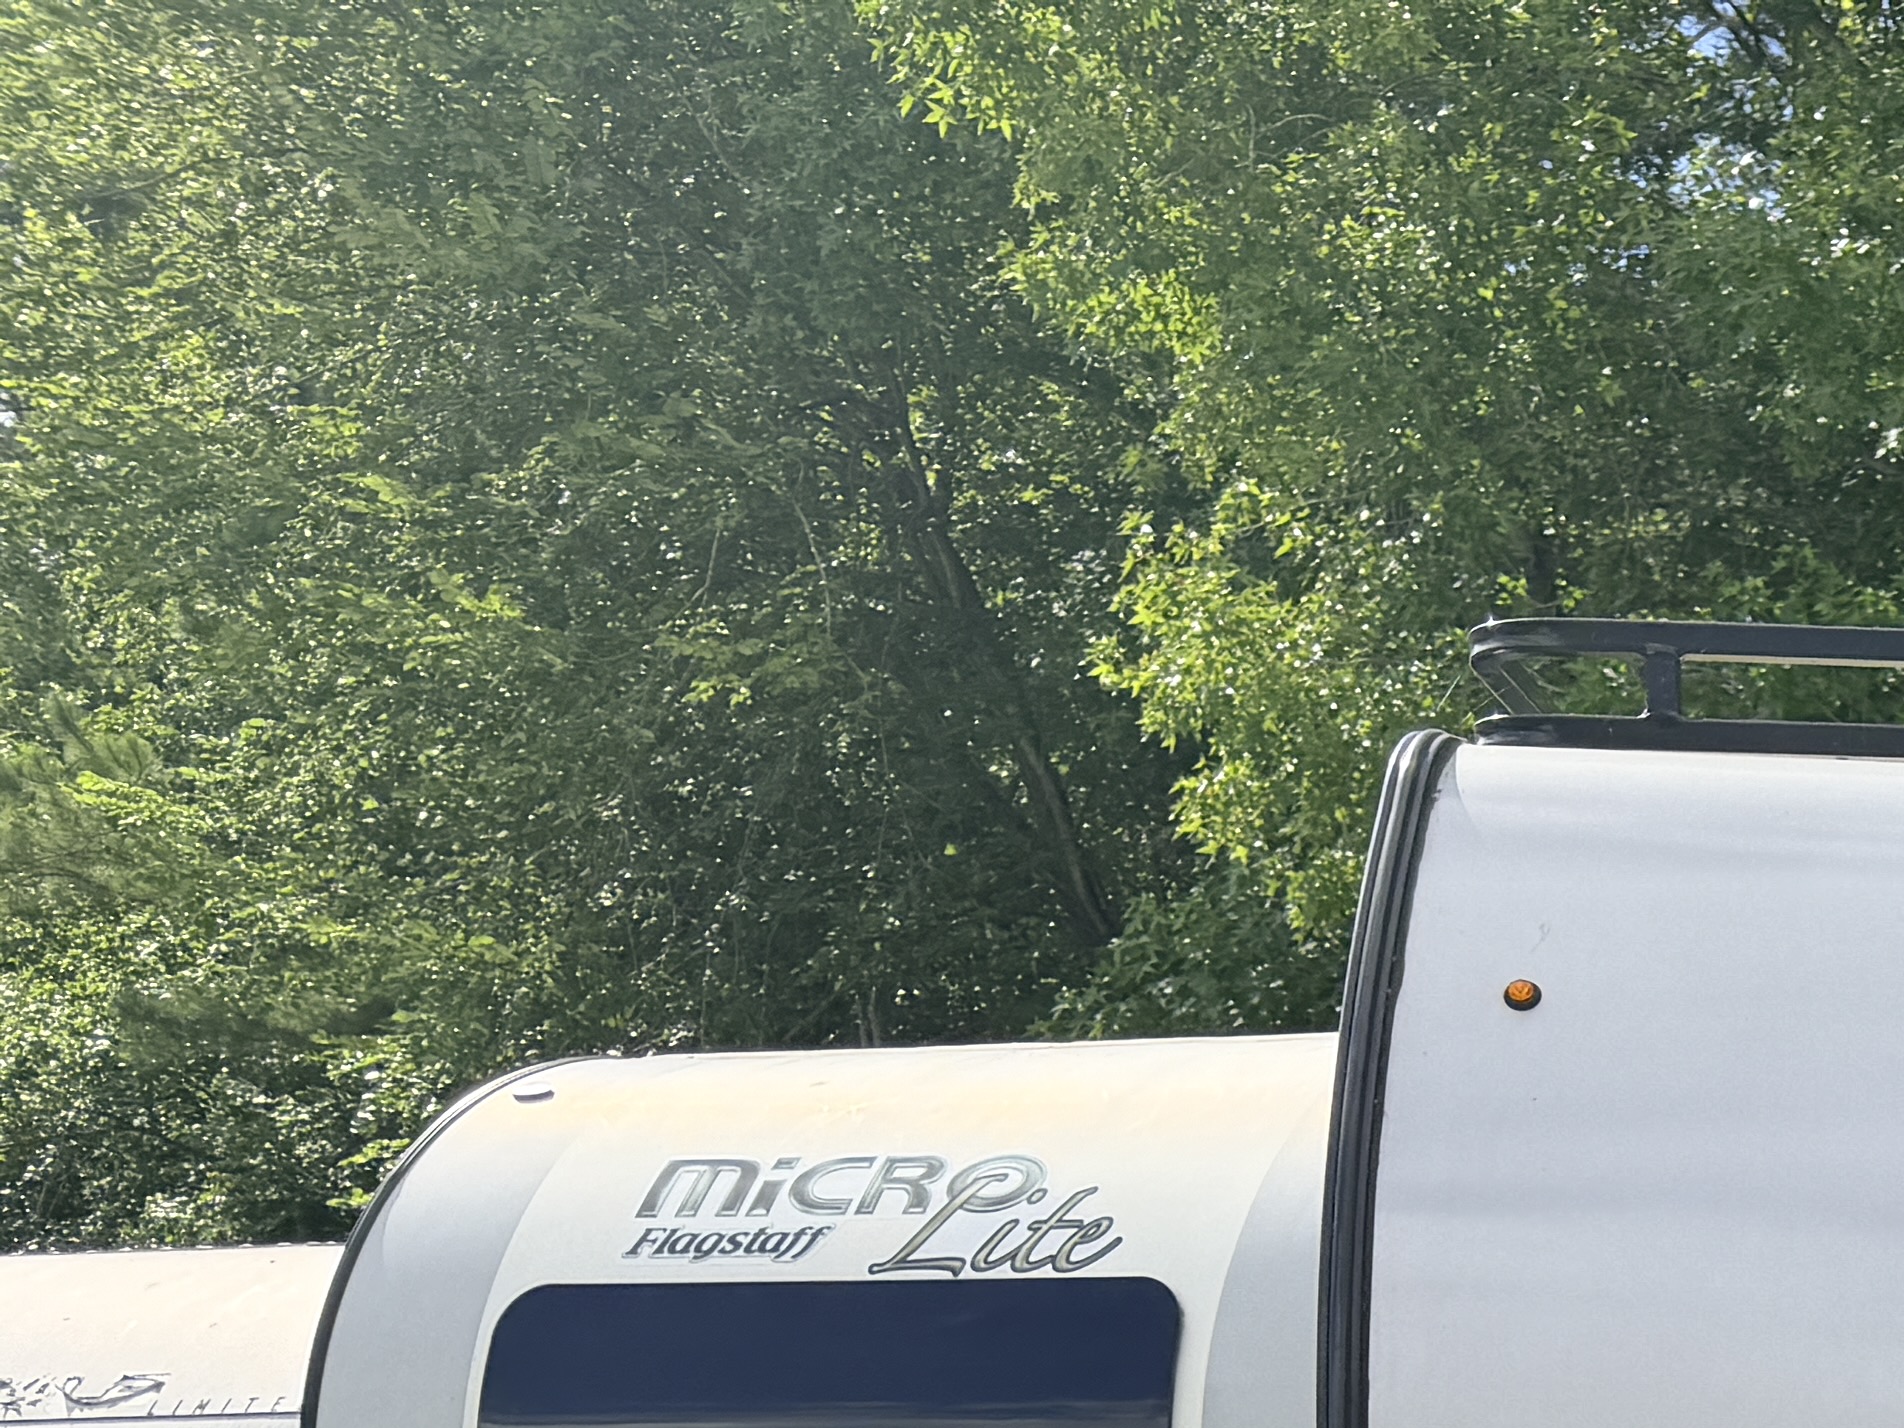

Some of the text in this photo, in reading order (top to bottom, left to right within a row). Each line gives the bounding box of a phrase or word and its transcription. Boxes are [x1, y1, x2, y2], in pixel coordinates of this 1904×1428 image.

[622, 1223, 836, 1263] Flagstaff
[867, 1171, 1124, 1277] Lite
[146, 1397, 300, 1416] LIMITE
